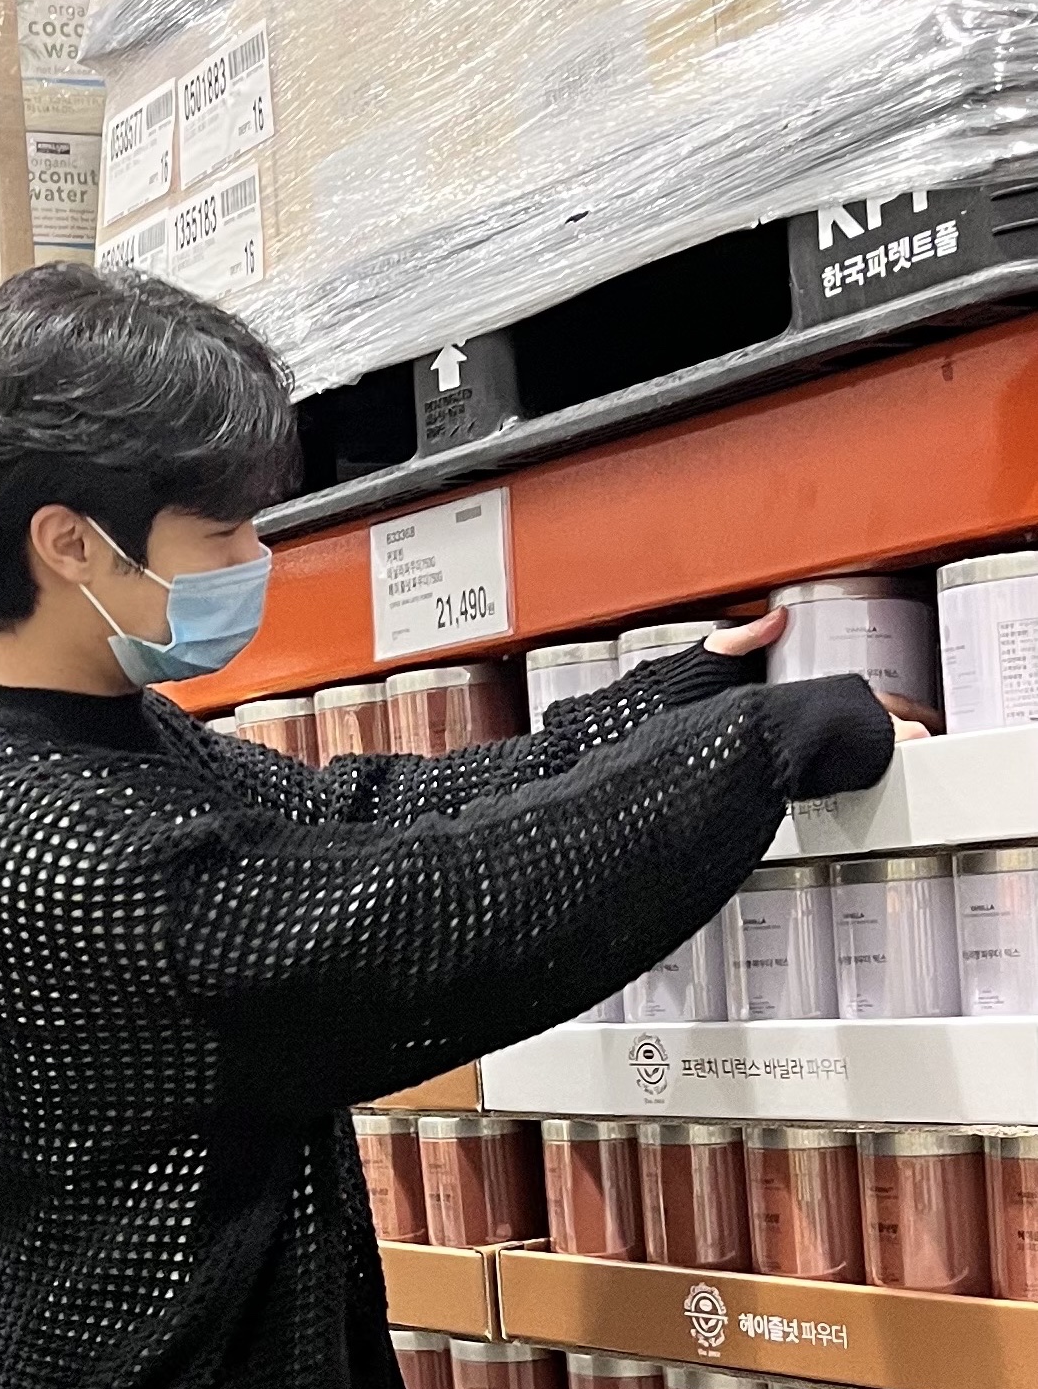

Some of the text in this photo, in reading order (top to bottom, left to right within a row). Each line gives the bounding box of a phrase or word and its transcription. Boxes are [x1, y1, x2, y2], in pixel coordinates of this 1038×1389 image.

[28, 169, 99, 185] oconut
[175, 195, 217, 252] 1355183
[821, 219, 959, 298] 한국파렛트풀
[681, 1057, 849, 1080] 프렌치 디럭스 바닐라 파우더
[738, 1312, 800, 1344] 헤이즐넛
[801, 1321, 848, 1350] 파우더
